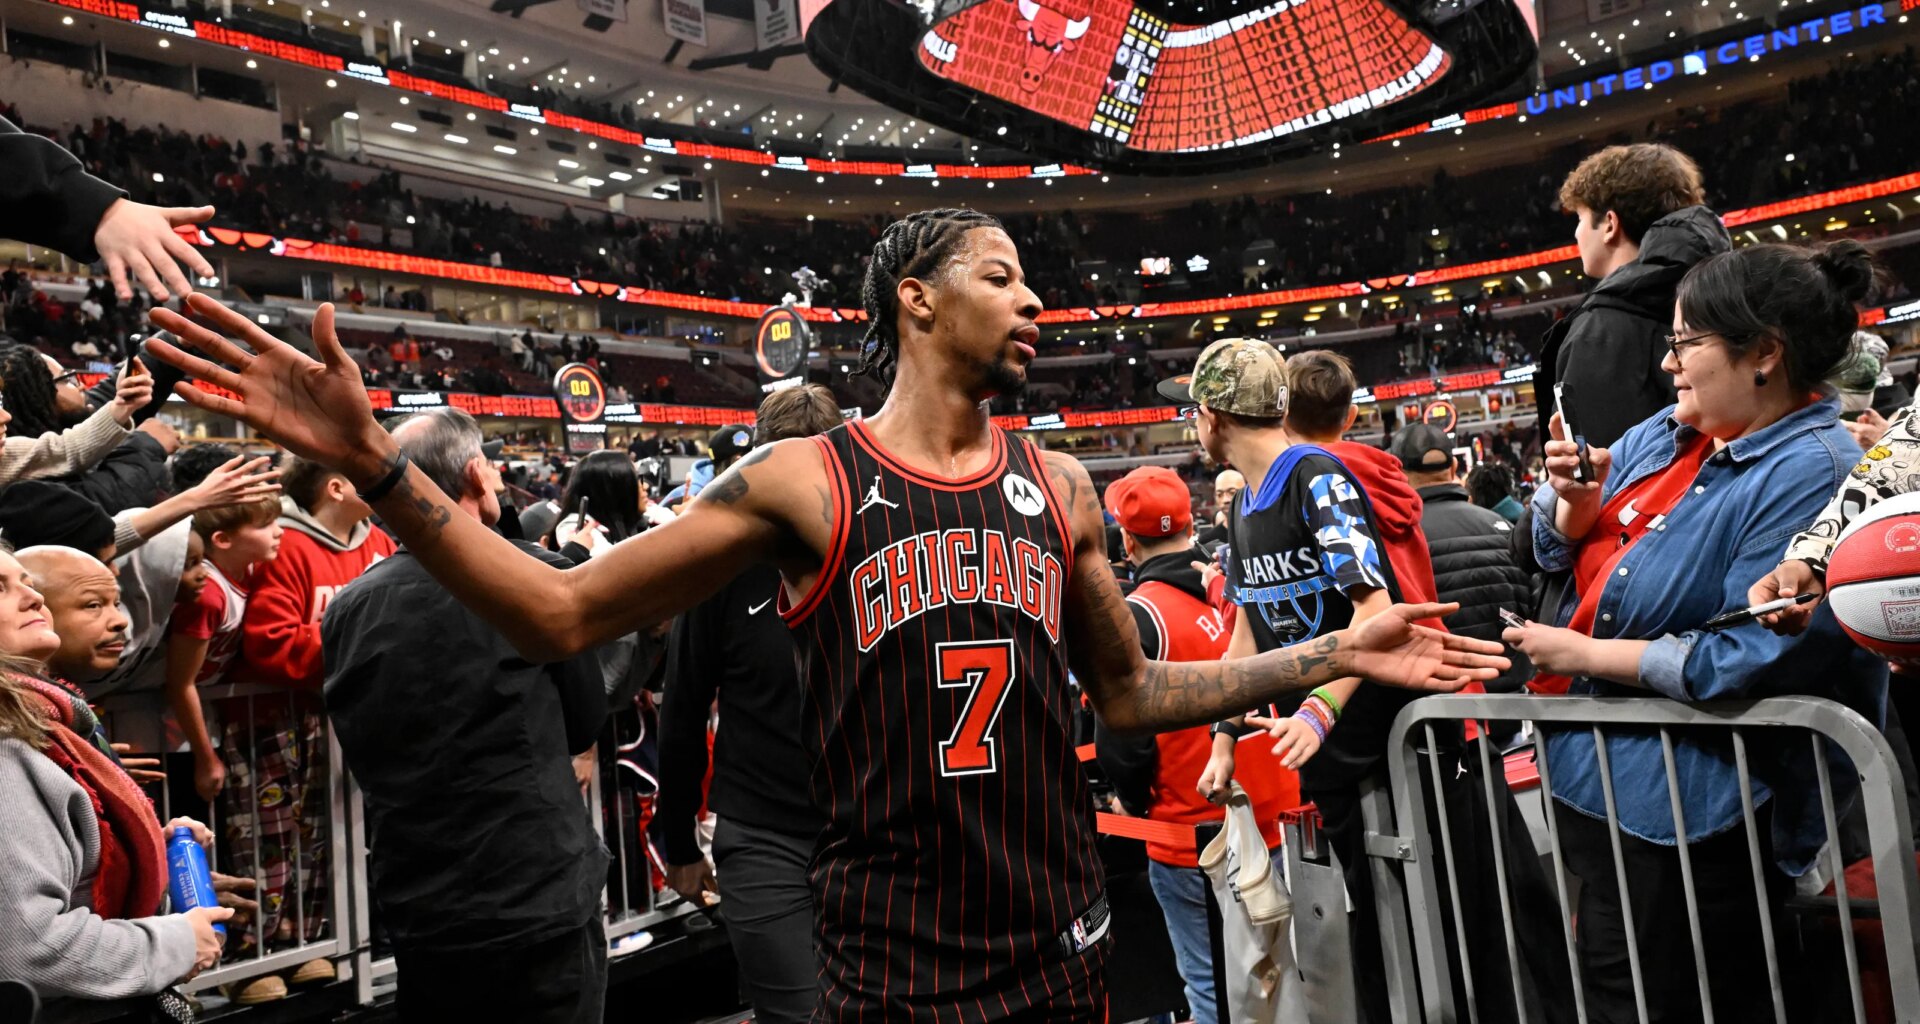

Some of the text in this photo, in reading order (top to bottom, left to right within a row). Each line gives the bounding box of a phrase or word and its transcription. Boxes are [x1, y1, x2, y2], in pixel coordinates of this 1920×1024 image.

[1235, 10, 1293, 45] BULLS
[1241, 25, 1298, 59] BULLS
[1298, 8, 1338, 34] WIN
[1246, 39, 1304, 74] BULLS
[1303, 22, 1343, 48] WIN
[1252, 53, 1310, 88] BULLS
[1308, 37, 1349, 63] WIN
[1257, 67, 1315, 100] BULLS
[1313, 52, 1354, 77] WIN
[1525, 3, 1886, 115] UNITED CENTER
[1232, 116, 1270, 138] WIN
[1268, 95, 1326, 127] BULLS
[1325, 80, 1365, 105] WIN
[1364, 58, 1412, 91] BULLS
[1262, 81, 1320, 115] BULLS
[1319, 66, 1360, 92] WIN
[1328, 93, 1371, 120] WIN
[1368, 70, 1421, 107] BULLS
[850, 528, 1062, 652] CHICAGO
[1242, 547, 1319, 585] HARKS
[935, 639, 1015, 777] 7
